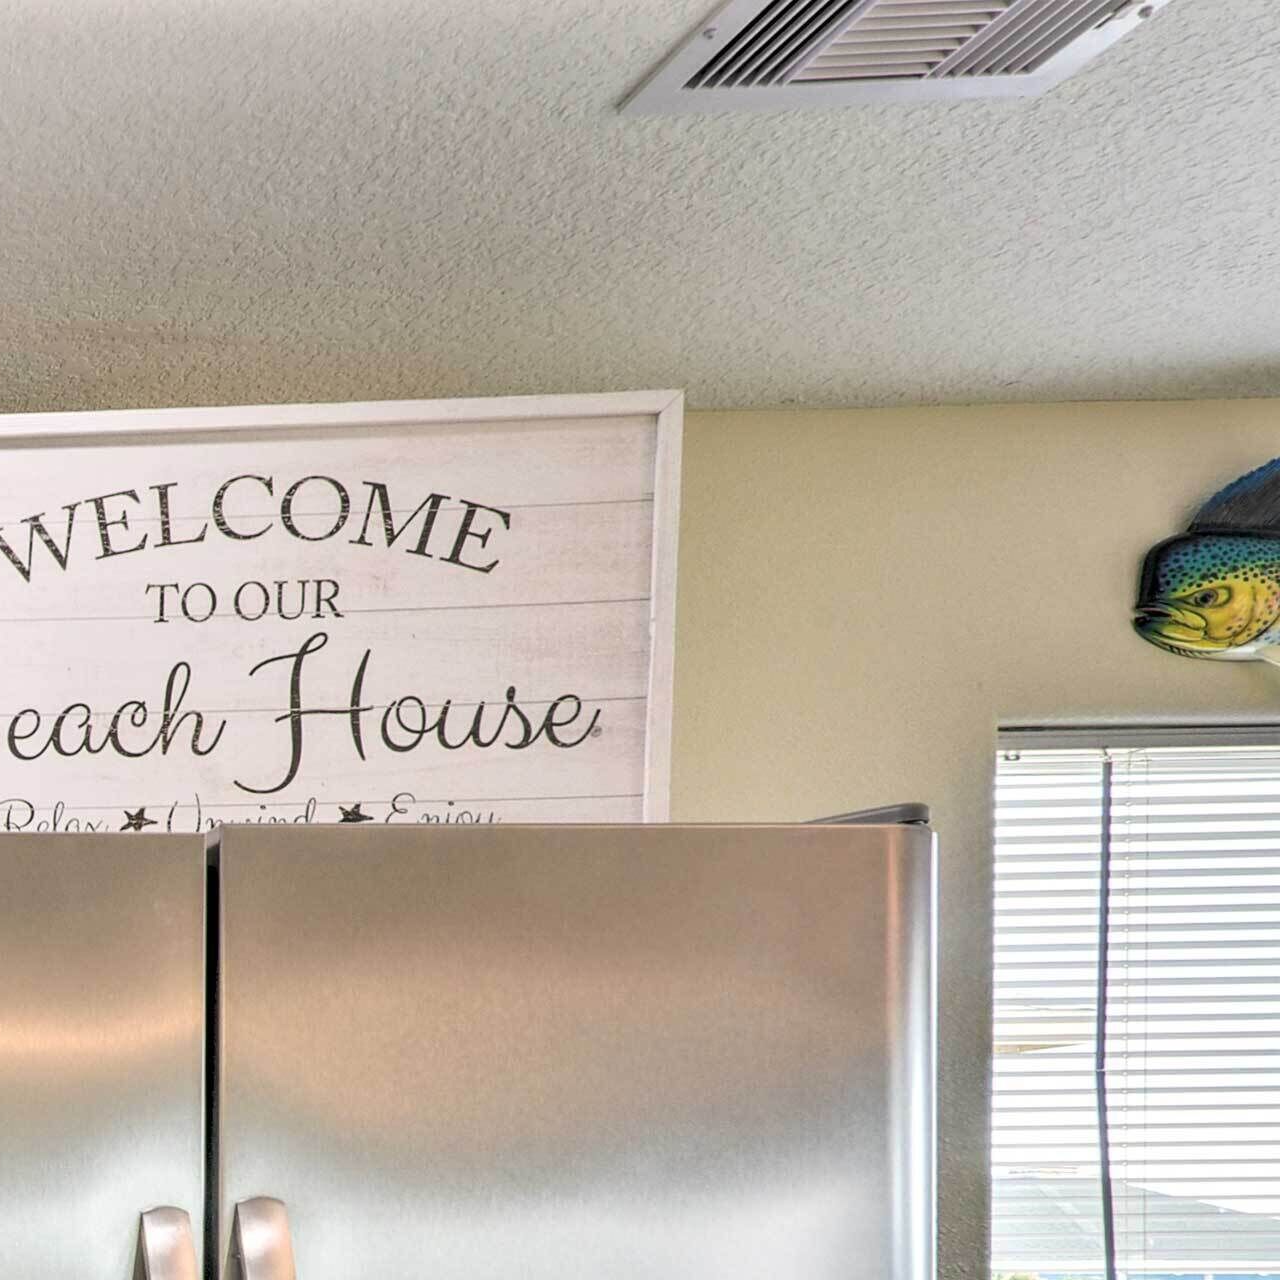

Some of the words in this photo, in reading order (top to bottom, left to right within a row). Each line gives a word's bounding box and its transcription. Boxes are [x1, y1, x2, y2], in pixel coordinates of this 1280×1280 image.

[144, 582, 218, 624] TO
[233, 578, 345, 622] OUR
[233, 631, 604, 795] House
